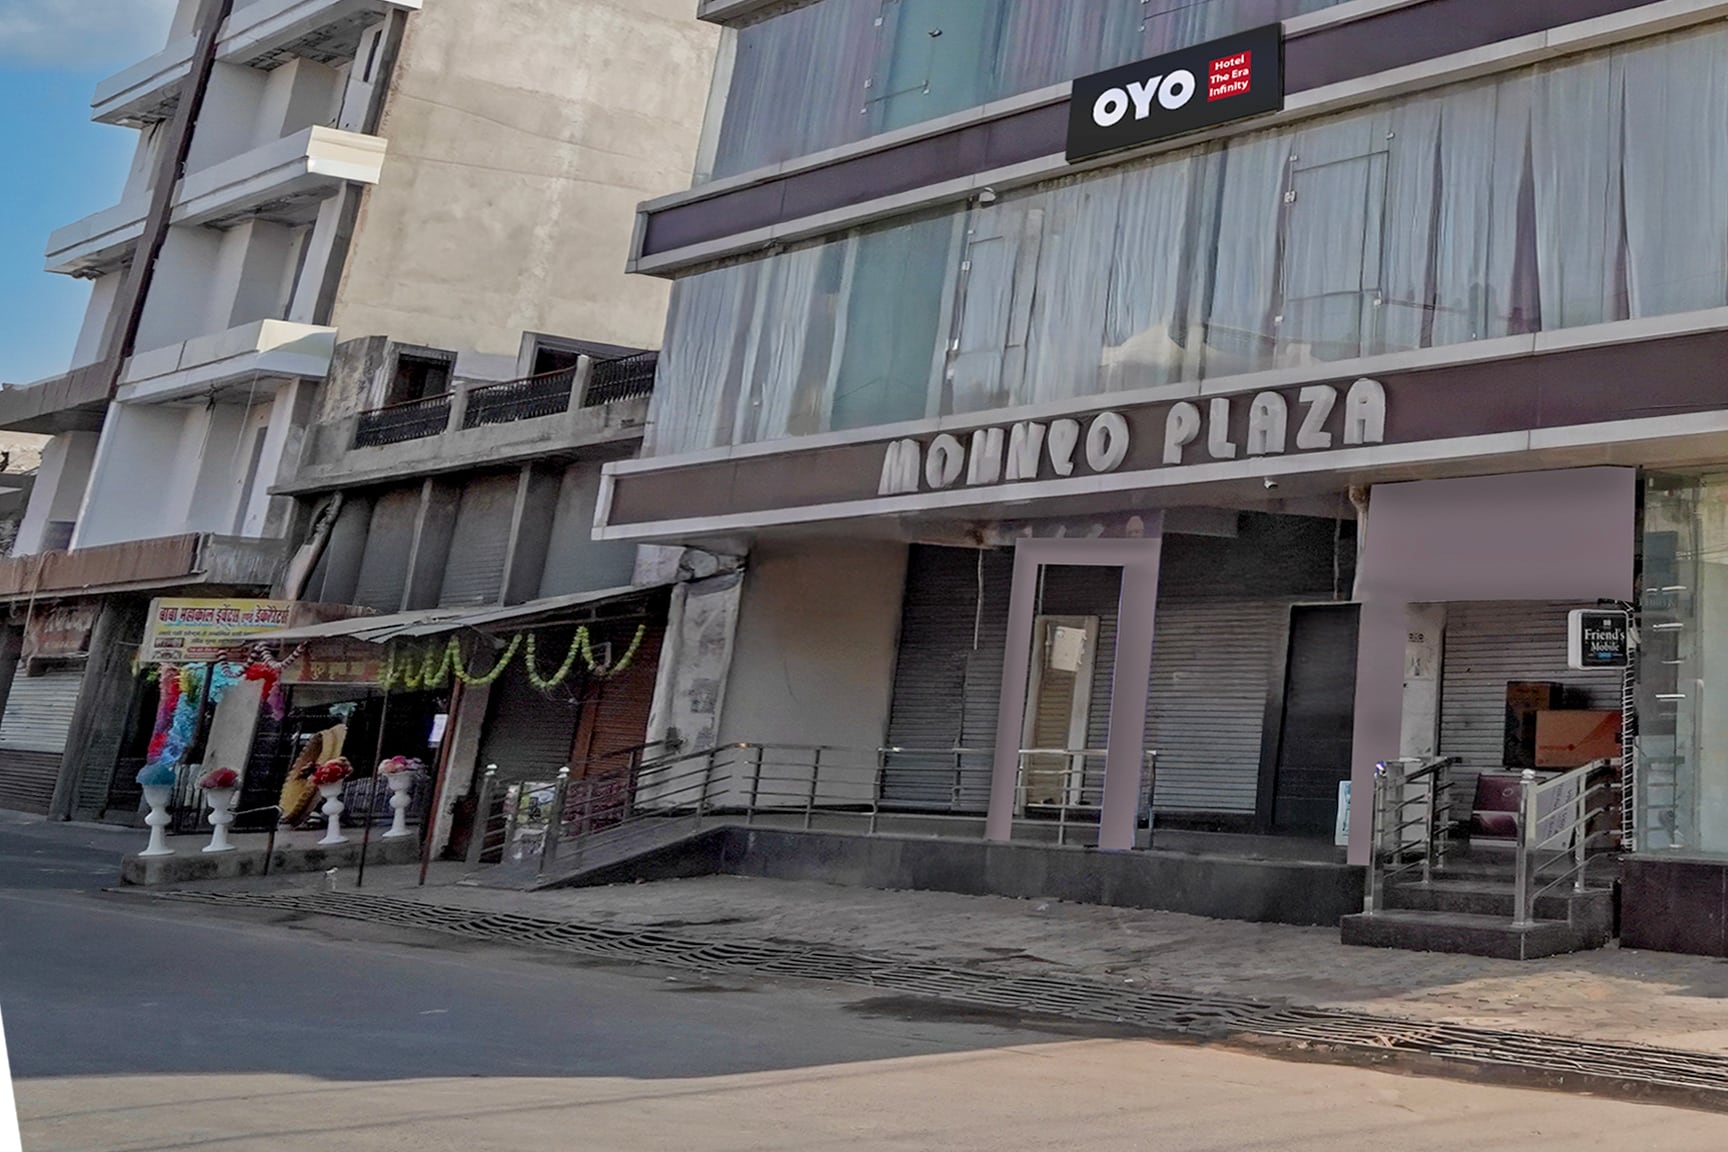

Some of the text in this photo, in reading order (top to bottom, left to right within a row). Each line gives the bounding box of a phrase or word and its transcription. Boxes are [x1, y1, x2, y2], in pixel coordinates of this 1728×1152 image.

[1214, 53, 1245, 71] Hotel
[1210, 68, 1250, 84] The Era
[1209, 79, 1249, 97] Infinity
[1092, 69, 1196, 127] OYO
[1162, 377, 1386, 464] PLAZA
[1584, 628, 1625, 641] Friend's
[1590, 641, 1620, 652] Mobile
